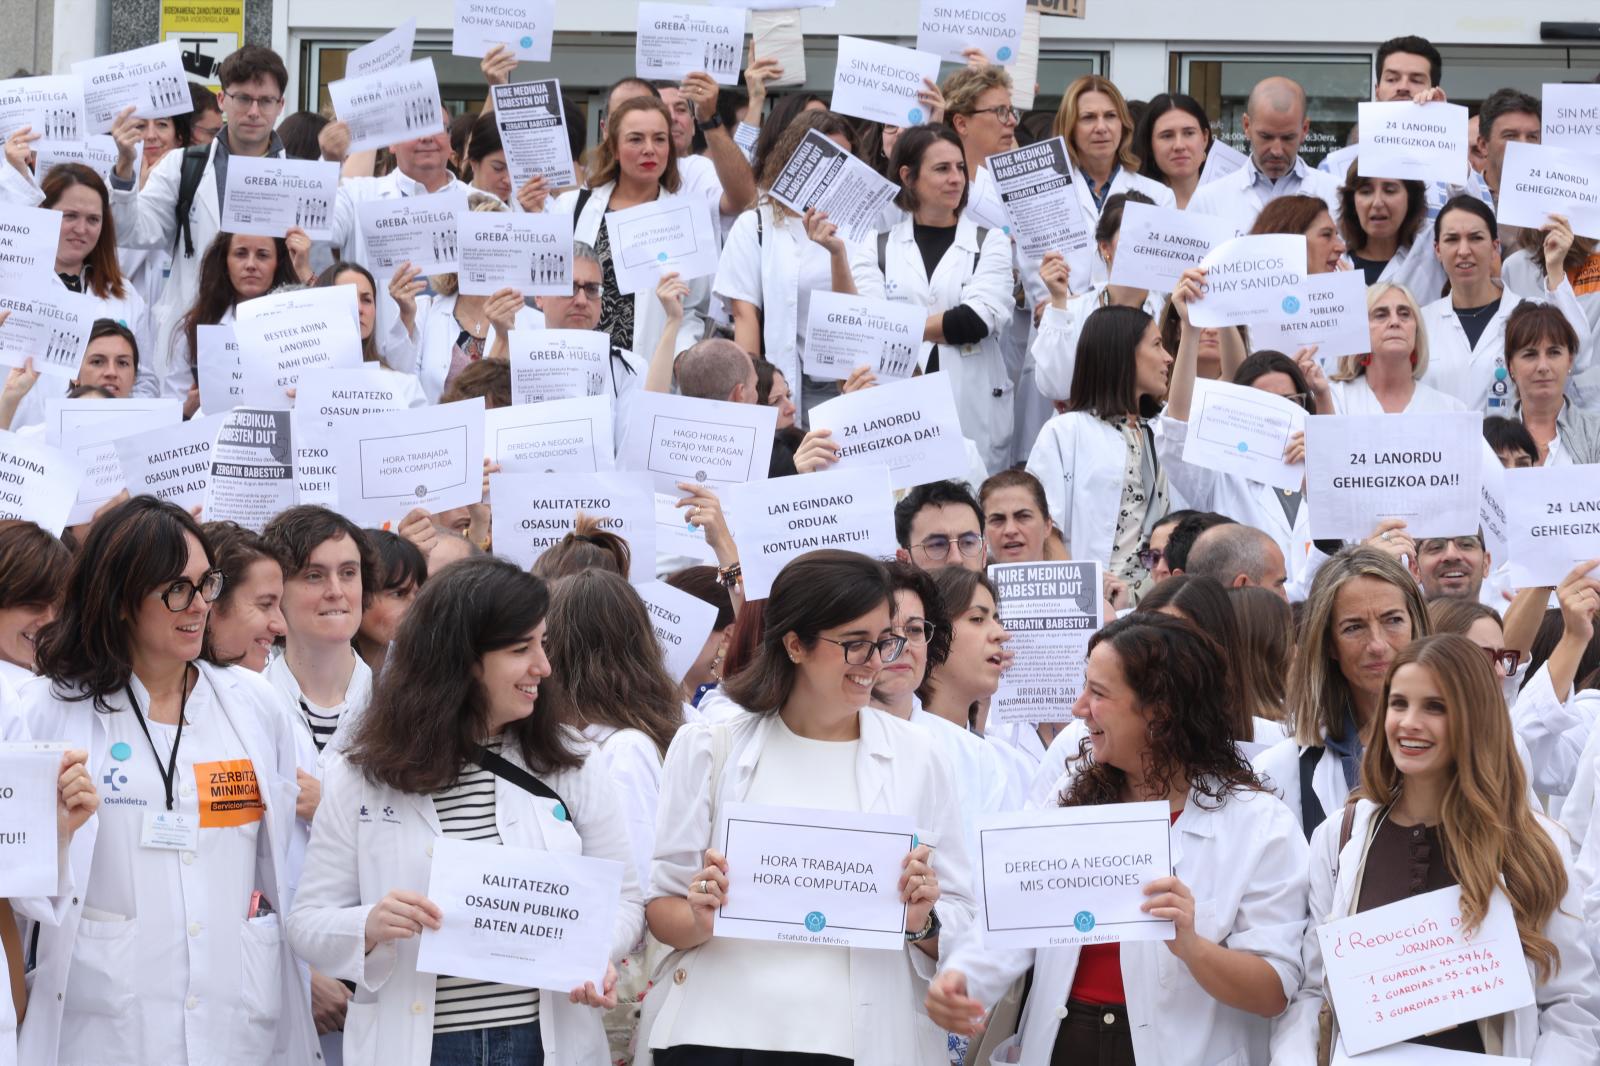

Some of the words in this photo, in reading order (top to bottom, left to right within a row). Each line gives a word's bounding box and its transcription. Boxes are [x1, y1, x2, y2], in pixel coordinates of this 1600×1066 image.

[470, 4, 484, 13] SIN
[485, 6, 526, 17] MÉDICOS
[934, 8, 952, 18] SIN
[954, 8, 1006, 23] MÉDICOS
[461, 16, 475, 24] NO
[476, 17, 493, 26] HAY
[495, 18, 536, 30] SANIDAD
[654, 21, 686, 31] GREBA
[690, 24, 729, 34] HUELGA
[922, 22, 940, 33] NO
[942, 23, 966, 36] HAY
[967, 25, 1016, 39] SANIDAD
[92, 71, 124, 86] GREBA
[128, 60, 167, 78] HUELGA
[851, 59, 869, 71] SIN
[870, 62, 920, 84] MÉDICOS
[839, 72, 856, 85] NO
[858, 76, 880, 90] HAY
[27, 92, 68, 102] HUELGA
[534, 94, 550, 104] DUT
[1557, 108, 1578, 119] SIN
[1386, 121, 1397, 130] 24
[1402, 122, 1447, 134] LANORDU
[1546, 124, 1566, 134] NO
[1568, 124, 1593, 135] HAY
[1374, 136, 1436, 149] GEHIEGIZKOA
[1438, 140, 1456, 152] DA!!
[992, 156, 1014, 168] NIRE
[1014, 144, 1052, 164] MEDIKUA
[996, 160, 1038, 180] BABESTEN
[1038, 154, 1056, 168] DUT
[244, 176, 278, 186] GREBA
[282, 179, 322, 189] HUELGA
[1529, 168, 1542, 178] 24
[1546, 171, 1589, 185] LANORDU
[1006, 187, 1036, 201] ZERGATIK
[1036, 178, 1067, 192] BABESTU?
[1515, 183, 1578, 199] GEHIEGIZKOA
[1579, 192, 1598, 203] DA!!
[376, 216, 408, 229] GREBA
[412, 212, 454, 224] HUELGA
[475, 232, 508, 241] GREBA
[514, 234, 556, 243] HUELGA
[1148, 232, 1160, 240] 24
[1164, 234, 1210, 250] LANORDU
[1133, 245, 1195, 263] GEHIEGIZKOA
[1224, 258, 1284, 274] MÉDICOS
[1212, 280, 1238, 293] HAY
[1240, 274, 1299, 290] SANIDAD
[38, 305, 79, 323] HUELGA
[264, 329, 299, 342] BESTEEK
[300, 320, 328, 332] ADINA
[828, 313, 862, 326] GREBA
[868, 318, 909, 334] HUELGA
[1280, 321, 1308, 332] BATEN
[1310, 319, 1338, 330] ALDE!!
[280, 338, 320, 354] LANORDU
[530, 350, 564, 361] GREBA
[569, 351, 600, 362] HUELGA
[278, 359, 300, 370] NAHI
[332, 390, 393, 400] KALITATEZKO
[320, 406, 359, 416] OSASUN
[844, 425, 858, 436] 24
[864, 410, 921, 432] LANORDU
[256, 430, 277, 444] DUT
[508, 442, 540, 451] DERECHO
[548, 437, 584, 447] NEGOCIAR
[673, 429, 698, 440] HAGO
[700, 432, 728, 443] HORAS
[833, 430, 912, 459] GEHIEGIZKOA
[914, 426, 941, 440] DA!!
[148, 442, 210, 464] KALITATEZKO
[514, 452, 528, 460] MIS
[528, 448, 578, 459] CONDICIONES
[660, 439, 696, 451] DESTAJO
[716, 446, 744, 456] PAGAN
[382, 454, 406, 464] HORA
[406, 448, 448, 461] TRABAJADA
[670, 452, 688, 462] CON
[690, 454, 732, 467] VOCACIÓN
[1350, 454, 1367, 465] 24
[1374, 452, 1442, 464] LANORDU
[10, 456, 45, 476] ADINA
[216, 464, 242, 476] ZERGATIK
[244, 466, 285, 478] BABESTU?
[380, 466, 403, 476] HORA
[404, 460, 452, 473] COMPUTADA
[145, 467, 180, 484] OSASUN
[1333, 476, 1426, 488] GEHIEGIZKOA
[1430, 474, 1459, 486] DA!!
[156, 484, 184, 499] BATEN
[533, 498, 610, 510] KALITATEZKO
[768, 504, 790, 516] LAN
[793, 494, 853, 512] EGINDAKO
[1546, 503, 1562, 514] 24
[522, 520, 570, 529] OSASUN
[788, 514, 838, 530] ORDUAK
[763, 537, 818, 554] KONTUAN
[822, 530, 870, 548] HARTU!!
[998, 568, 1024, 584] NIRE
[1028, 566, 1082, 582] MEDIKUA
[999, 582, 1056, 598] BABESTEN
[1060, 582, 1082, 595] DUT
[1003, 618, 1044, 630] ZERGATIK
[1046, 617, 1090, 628] BABESTU?
[1017, 688, 1056, 696] URRIAREN
[1060, 687, 1076, 696] 3AN
[104, 797, 148, 806] Osakidetza
[760, 854, 798, 868] HORA
[802, 858, 874, 875] TRABAJADA
[1004, 858, 1068, 874] DERECHO
[1071, 858, 1080, 869] A
[1084, 853, 1152, 868] NEGOCIAR
[482, 874, 570, 896] KALITATEZKO
[753, 872, 790, 886] HORA
[794, 876, 878, 894] COMPUTADA
[1020, 879, 1044, 892] MIS
[1047, 874, 1140, 890] CONDICIONES
[465, 895, 520, 913] OSASUN
[523, 903, 580, 920] PUBLIKO
[474, 917, 518, 934] BATEN
[520, 924, 564, 940] ALDE!!
[778, 932, 808, 942] Estatuto
[810, 934, 822, 943] del
[822, 935, 850, 945] Médico
[1050, 935, 1079, 944] Estatuto
[1081, 934, 1092, 944] del
[1094, 933, 1120, 942] Médico
[1396, 936, 1455, 956] JORNADA
[1372, 994, 1380, 1002] 2
[1376, 1011, 1384, 1022] 3
